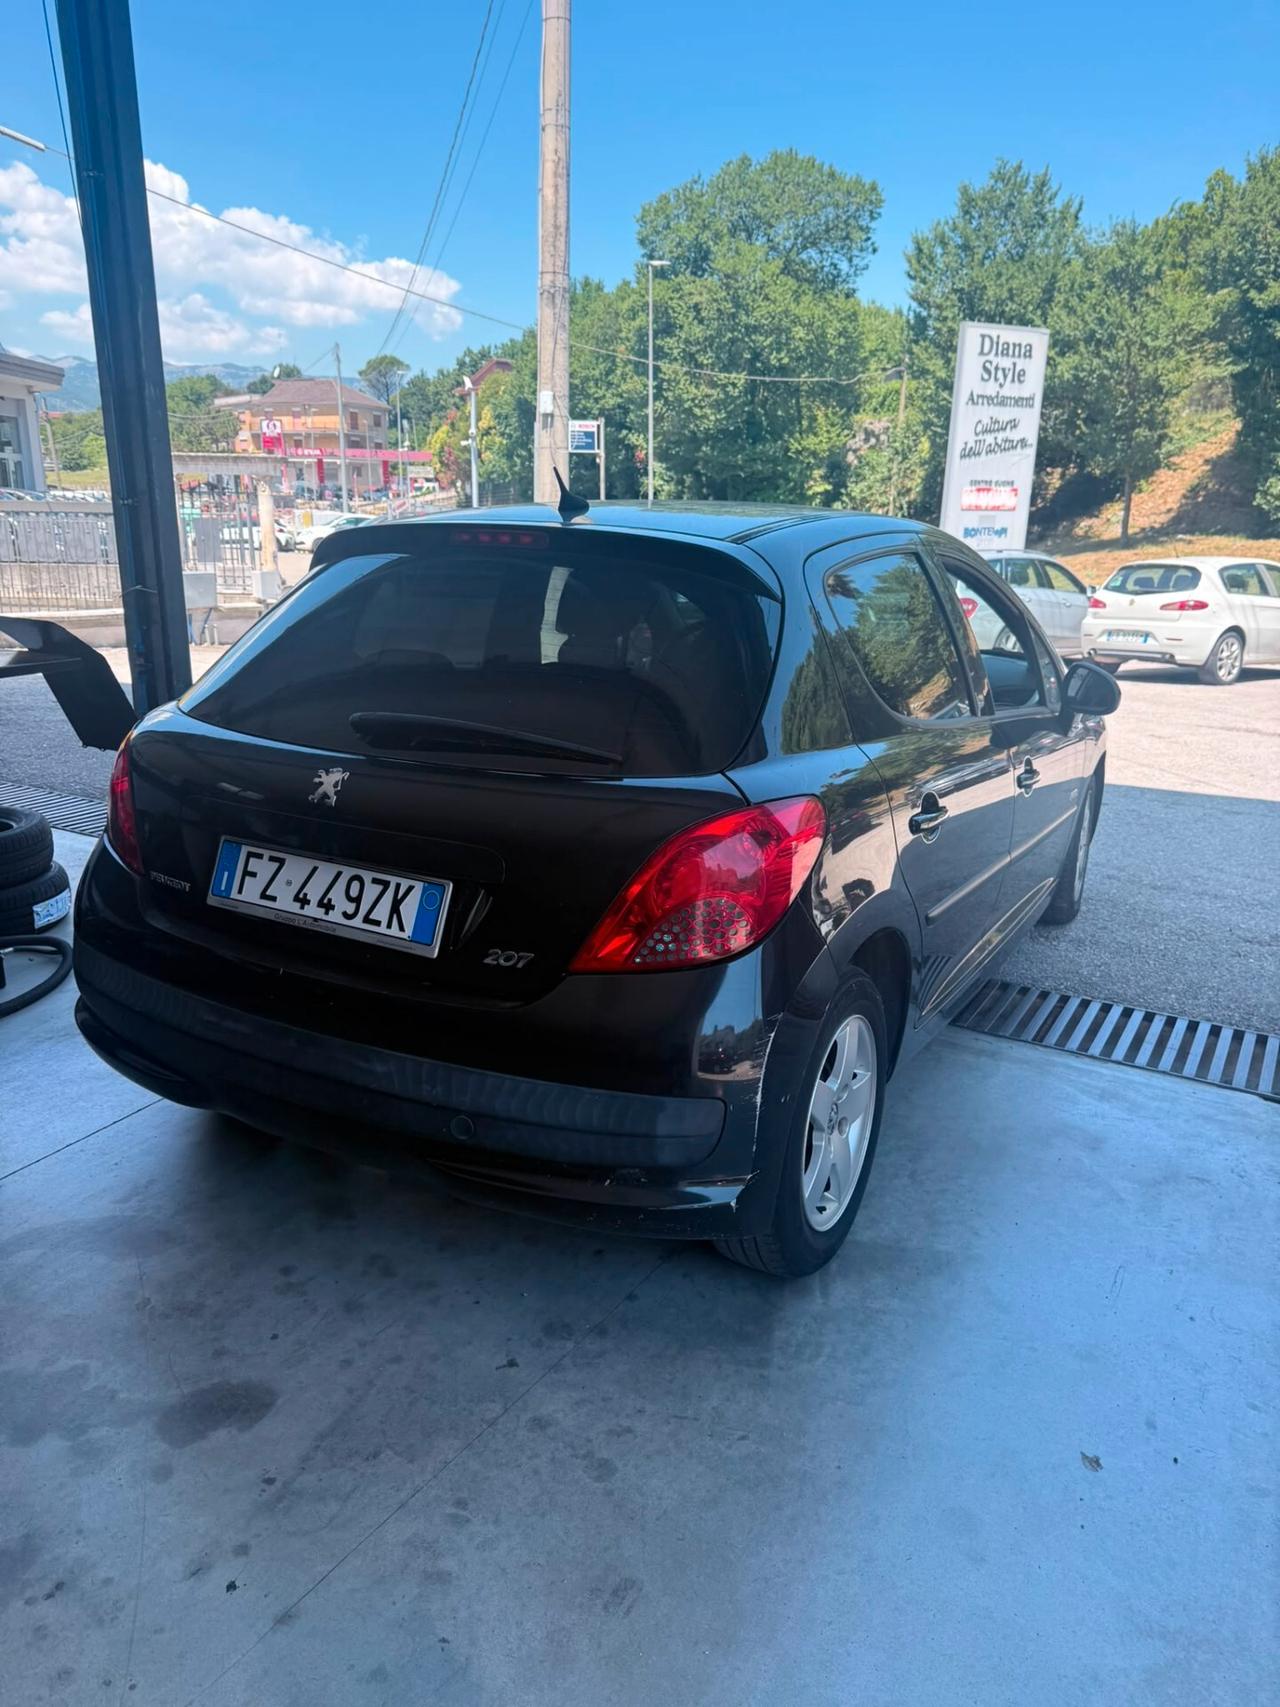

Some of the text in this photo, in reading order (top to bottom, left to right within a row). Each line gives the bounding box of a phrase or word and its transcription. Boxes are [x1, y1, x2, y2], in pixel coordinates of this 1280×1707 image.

[978, 333, 1033, 359] Diana
[980, 359, 1026, 388] Style
[966, 389, 1036, 409] Arredamenti
[974, 416, 1020, 437] Cultura
[482, 947, 536, 969] 207
